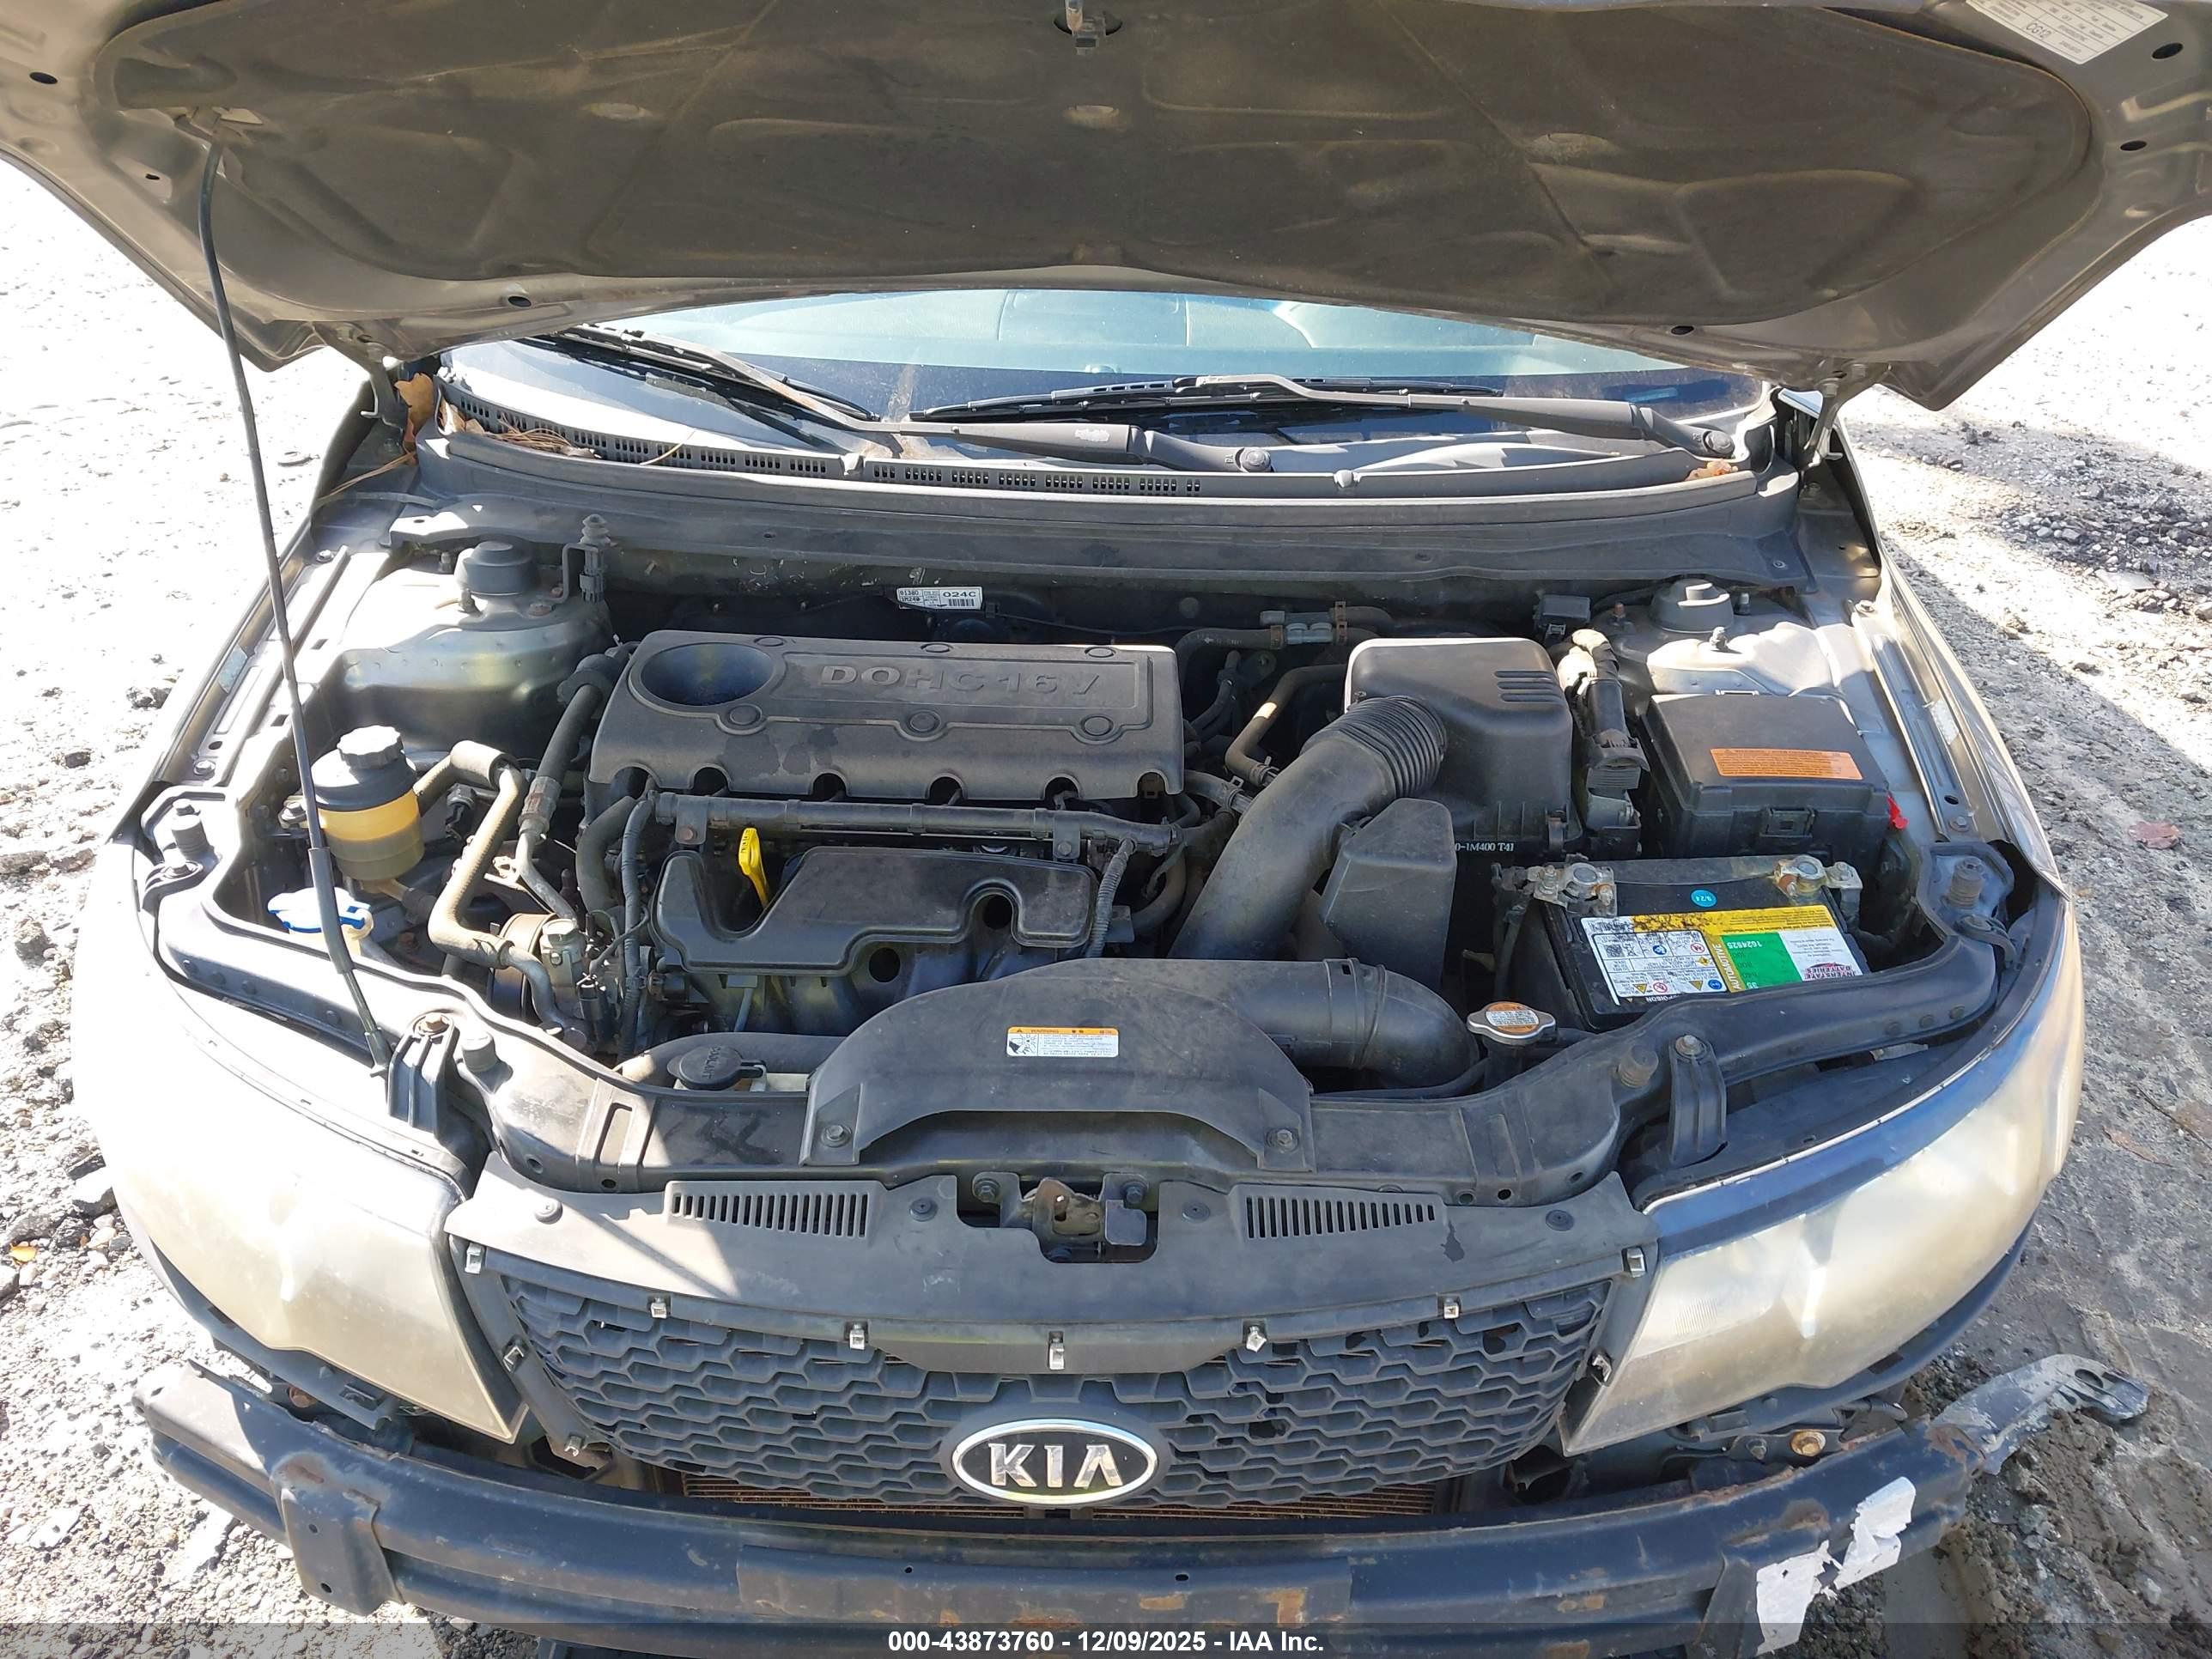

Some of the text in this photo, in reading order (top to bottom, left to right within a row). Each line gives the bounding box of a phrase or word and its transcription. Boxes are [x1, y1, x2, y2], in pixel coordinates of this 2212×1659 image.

[820, 665, 987, 692] DOHC
[1711, 944, 1741, 992] AUTOMOTIVE
[1804, 970, 1856, 981] INTERSTATE
[988, 1443, 1124, 1489] KIA
